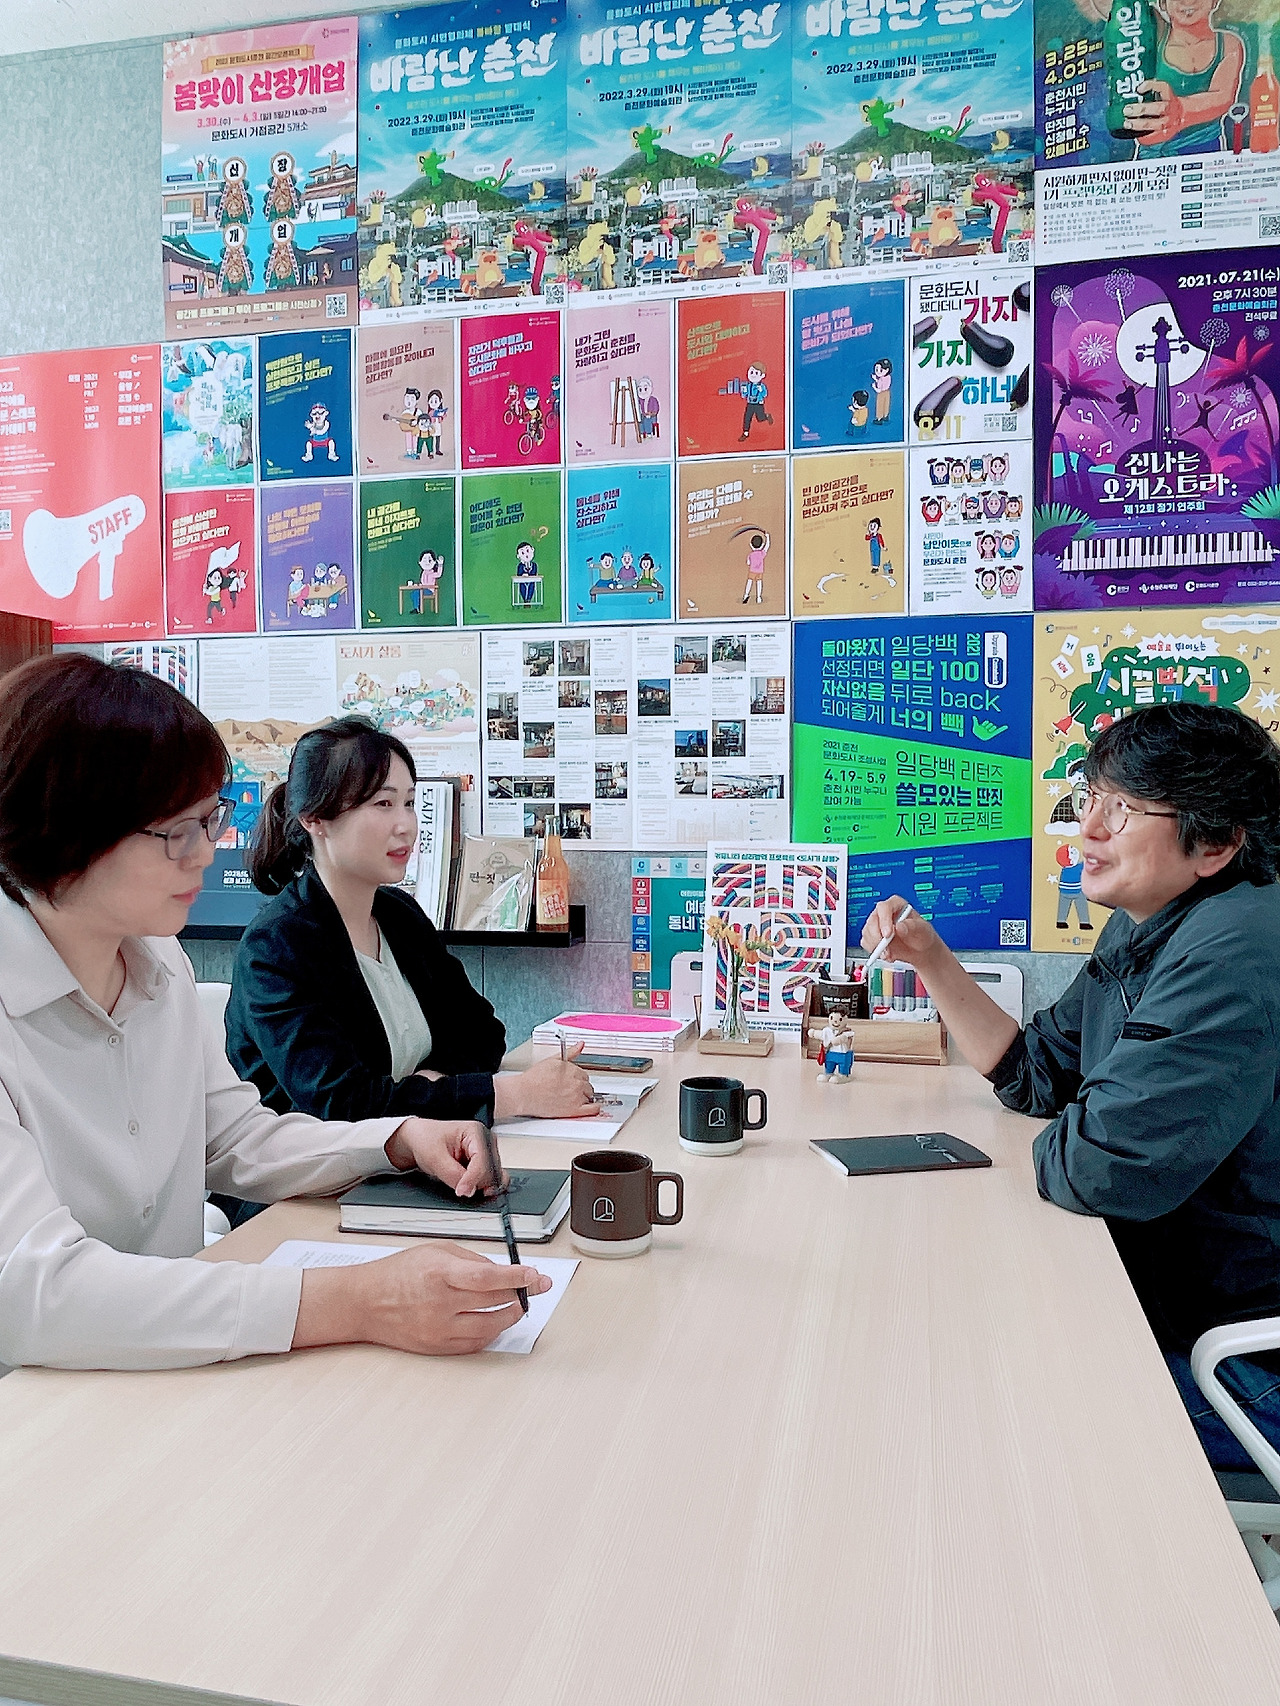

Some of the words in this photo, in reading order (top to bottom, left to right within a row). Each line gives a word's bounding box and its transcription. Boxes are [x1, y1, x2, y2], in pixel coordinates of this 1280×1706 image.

[580, 17, 695, 65] 바람난
[700, 3, 782, 55] 춘천
[1116, 1, 1145, 104] 일당백
[370, 47, 477, 92] 바람난
[481, 32, 558, 82] 춘천
[174, 73, 243, 112] 봄맞이
[249, 61, 345, 103] 신장개업
[1045, 82, 1086, 104] 춘천시민
[1045, 99, 1084, 117] 누구나
[211, 127, 247, 141] 문화도시
[250, 123, 285, 138] 거점공간
[287, 121, 308, 132] 5개소
[1045, 115, 1076, 133] 딴짓을
[1045, 129, 1076, 147] 신청할
[1078, 124, 1090, 136] 수
[1045, 139, 1090, 159] 있습니다.
[229, 162, 240, 176] 신
[277, 158, 287, 173] 장
[1044, 174, 1087, 188] 시원하게
[1114, 168, 1135, 181] 없이
[1044, 188, 1058, 200] 1기
[1121, 181, 1143, 194] 공개
[1044, 202, 1068, 210] 일상에서
[229, 229, 239, 243] 개
[278, 224, 287, 239] 업
[1178, 267, 1280, 288] 2021.07.21(수)
[920, 280, 978, 299] 문화도시
[1213, 290, 1232, 301] 오후
[1235, 288, 1250, 299] 7시
[1252, 286, 1277, 297] 30분
[920, 299, 961, 313] 됐다더니
[964, 296, 1017, 324] 가지
[1213, 300, 1277, 313] 춘천문화예술회관
[802, 312, 829, 327] 도시를
[832, 307, 850, 319] 위해
[1245, 311, 1277, 321] 전석무료
[575, 335, 591, 347] 내가
[594, 329, 610, 341] 그린
[802, 334, 829, 350] 준비가
[365, 350, 387, 363] 마을에
[390, 343, 412, 356] 필요한
[469, 341, 490, 355] 자전거
[509, 341, 532, 355] 바꾸고
[576, 341, 607, 358] 문화도시
[576, 352, 607, 368] 자랑하고
[611, 343, 640, 359] 싶다면?
[687, 343, 718, 360] 싶다면?
[918, 340, 972, 368] 가지
[304, 366, 332, 381] 있다면?
[366, 369, 393, 384] 싶다면?
[469, 361, 497, 377] 싶다면?
[963, 376, 1017, 405] 하네
[1125, 451, 1200, 475] 신나는
[803, 487, 811, 497] 빈
[814, 475, 858, 494] 야외공간을
[577, 494, 600, 507] 동네를
[604, 489, 620, 500] 위해
[688, 489, 713, 502] 우리는
[688, 499, 714, 513] 어떻게
[744, 490, 753, 499] 수
[802, 494, 828, 507] 새로운
[832, 484, 868, 501] 공간으로
[803, 502, 838, 519] 변신시켜
[841, 497, 858, 509] 주고
[862, 489, 894, 505] 싶다면?
[368, 508, 376, 518] 내
[377, 501, 400, 516] 공간을
[470, 497, 501, 513] 어디에도
[496, 508, 503, 516] 수
[577, 500, 617, 518] 잔소리하고
[1124, 504, 1155, 514] 제12회
[1157, 503, 1175, 512] 정기
[1177, 501, 1205, 511] 연주회
[496, 513, 524, 527] 있다면?
[577, 514, 605, 528] 싶다면?
[688, 508, 719, 524] 있을까?
[88, 508, 132, 544] STAFF
[202, 526, 230, 540] 싶다면?
[392, 518, 420, 533] 싶다면?
[923, 539, 971, 550] 낭만이웃으로
[924, 532, 943, 540] 시민이
[923, 550, 944, 558] 우리가
[946, 549, 966, 557] 만드는
[923, 558, 951, 566] 문화도시
[340, 646, 375, 659] 도시가
[822, 638, 885, 658] 돌아왔지
[892, 634, 957, 657] 일당백
[966, 633, 981, 656] 2021
[1146, 641, 1171, 652] 예술로
[822, 657, 884, 679] 선정되면
[891, 660, 934, 681] 일단
[941, 661, 979, 682] 100
[1096, 665, 1218, 705] 시끌벅적
[822, 680, 885, 701] 자신없음
[891, 685, 933, 706] 뒤로
[941, 687, 1001, 712] back
[822, 699, 885, 724] 되어줄게
[891, 707, 932, 732] 너의
[823, 741, 840, 749] 2021
[843, 743, 858, 752] 춘천
[823, 751, 856, 762] 문화도시
[896, 751, 956, 778] 일당백
[961, 761, 1004, 784] 리턴즈
[867, 772, 886, 783] 5.9
[823, 785, 841, 795] 춘천
[844, 786, 862, 795] 시민
[864, 786, 887, 796] 누구나
[896, 784, 972, 807] 쓸모있는
[977, 788, 1003, 807] 딴짓
[422, 788, 433, 824] 도시가
[845, 797, 862, 805] 가능
[896, 812, 937, 837] 지원
[944, 811, 1003, 834] 프로젝트
[470, 872, 495, 884] 딴-짓
[669, 915, 696, 930] 동네
